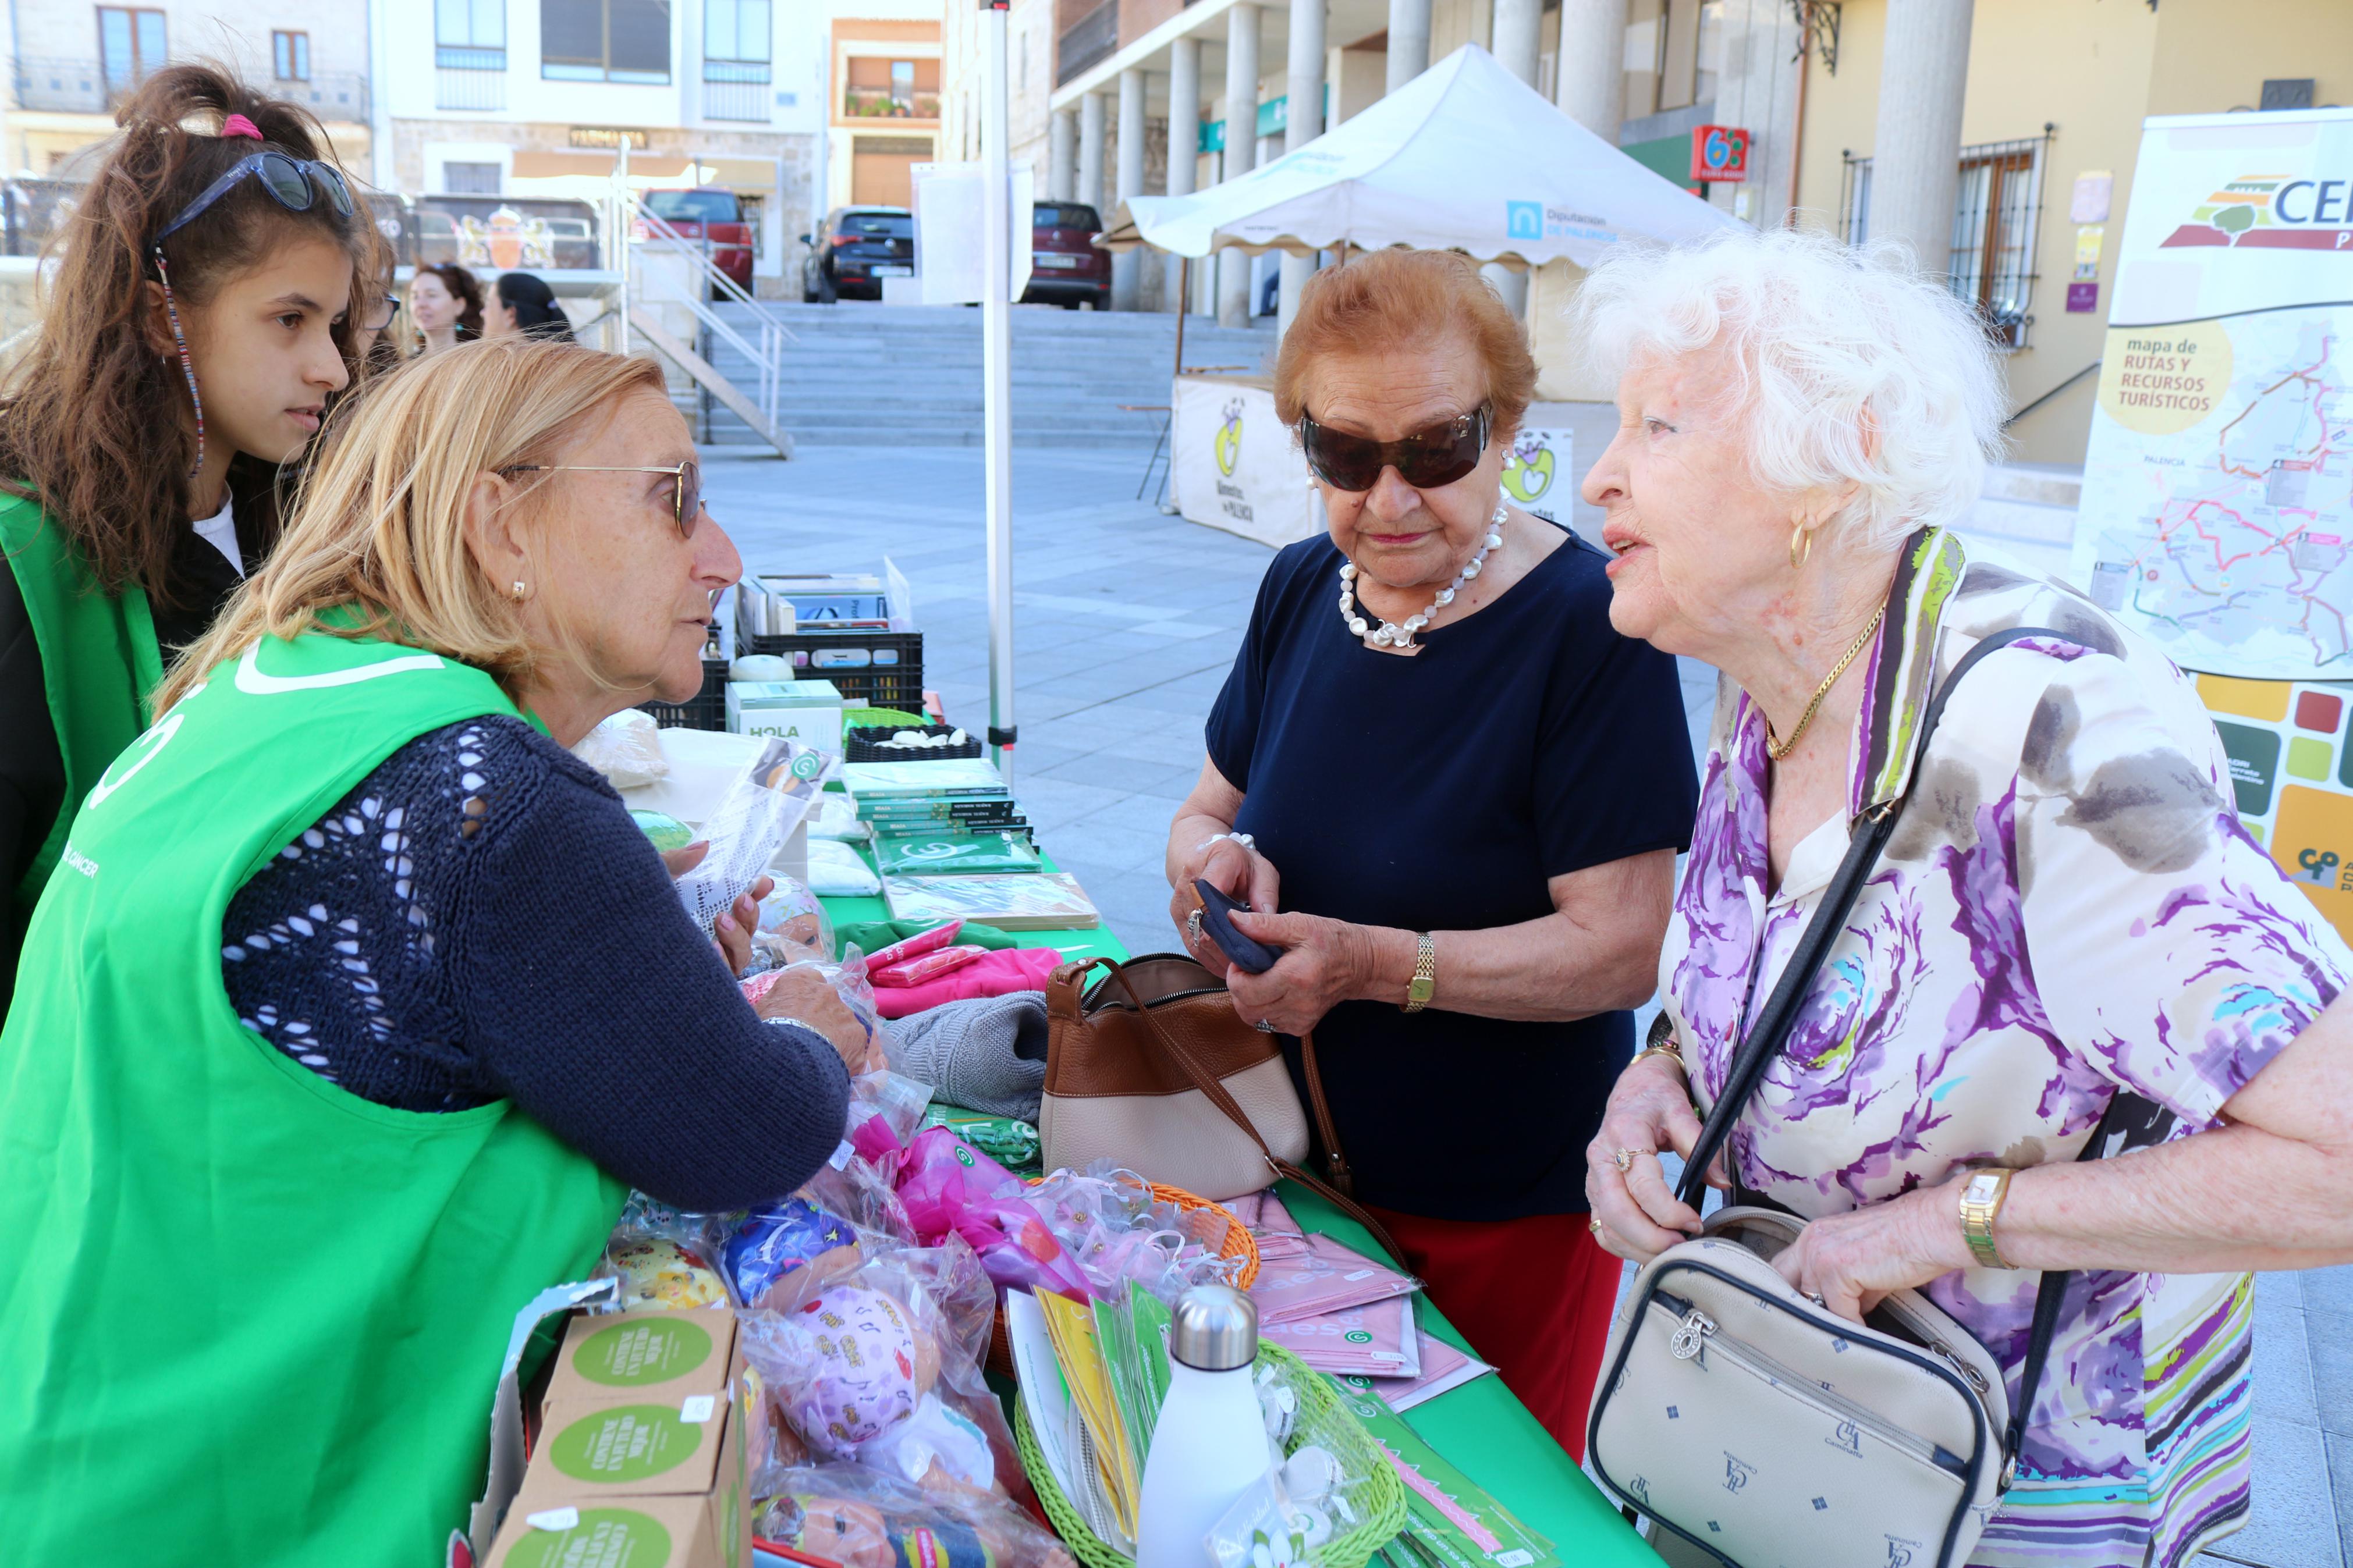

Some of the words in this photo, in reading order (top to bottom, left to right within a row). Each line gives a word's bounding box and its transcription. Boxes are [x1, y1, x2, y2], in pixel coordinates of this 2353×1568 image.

[2127, 339, 2172, 354] mapa
[2177, 339, 2197, 354] de
[2124, 355, 2175, 371] RUTAS
[2181, 358, 2191, 372] Y
[2121, 373, 2205, 392] RECURSOS
[2119, 390, 2210, 411] TURÍSTICOS
[750, 726, 799, 738] HOLA
[68, 850, 99, 879] CÁNCER
[611, 1331, 636, 1375] CONTIENE
[591, 1418, 619, 1470] CONTIENE
[1825, 1437, 1864, 1459] Caminatta
[1723, 1450, 1758, 1475] Caminatta
[1436, 1541, 1449, 1551] un
[1884, 1533, 1922, 1549] Caminatta
[1447, 1551, 1460, 1560] es
